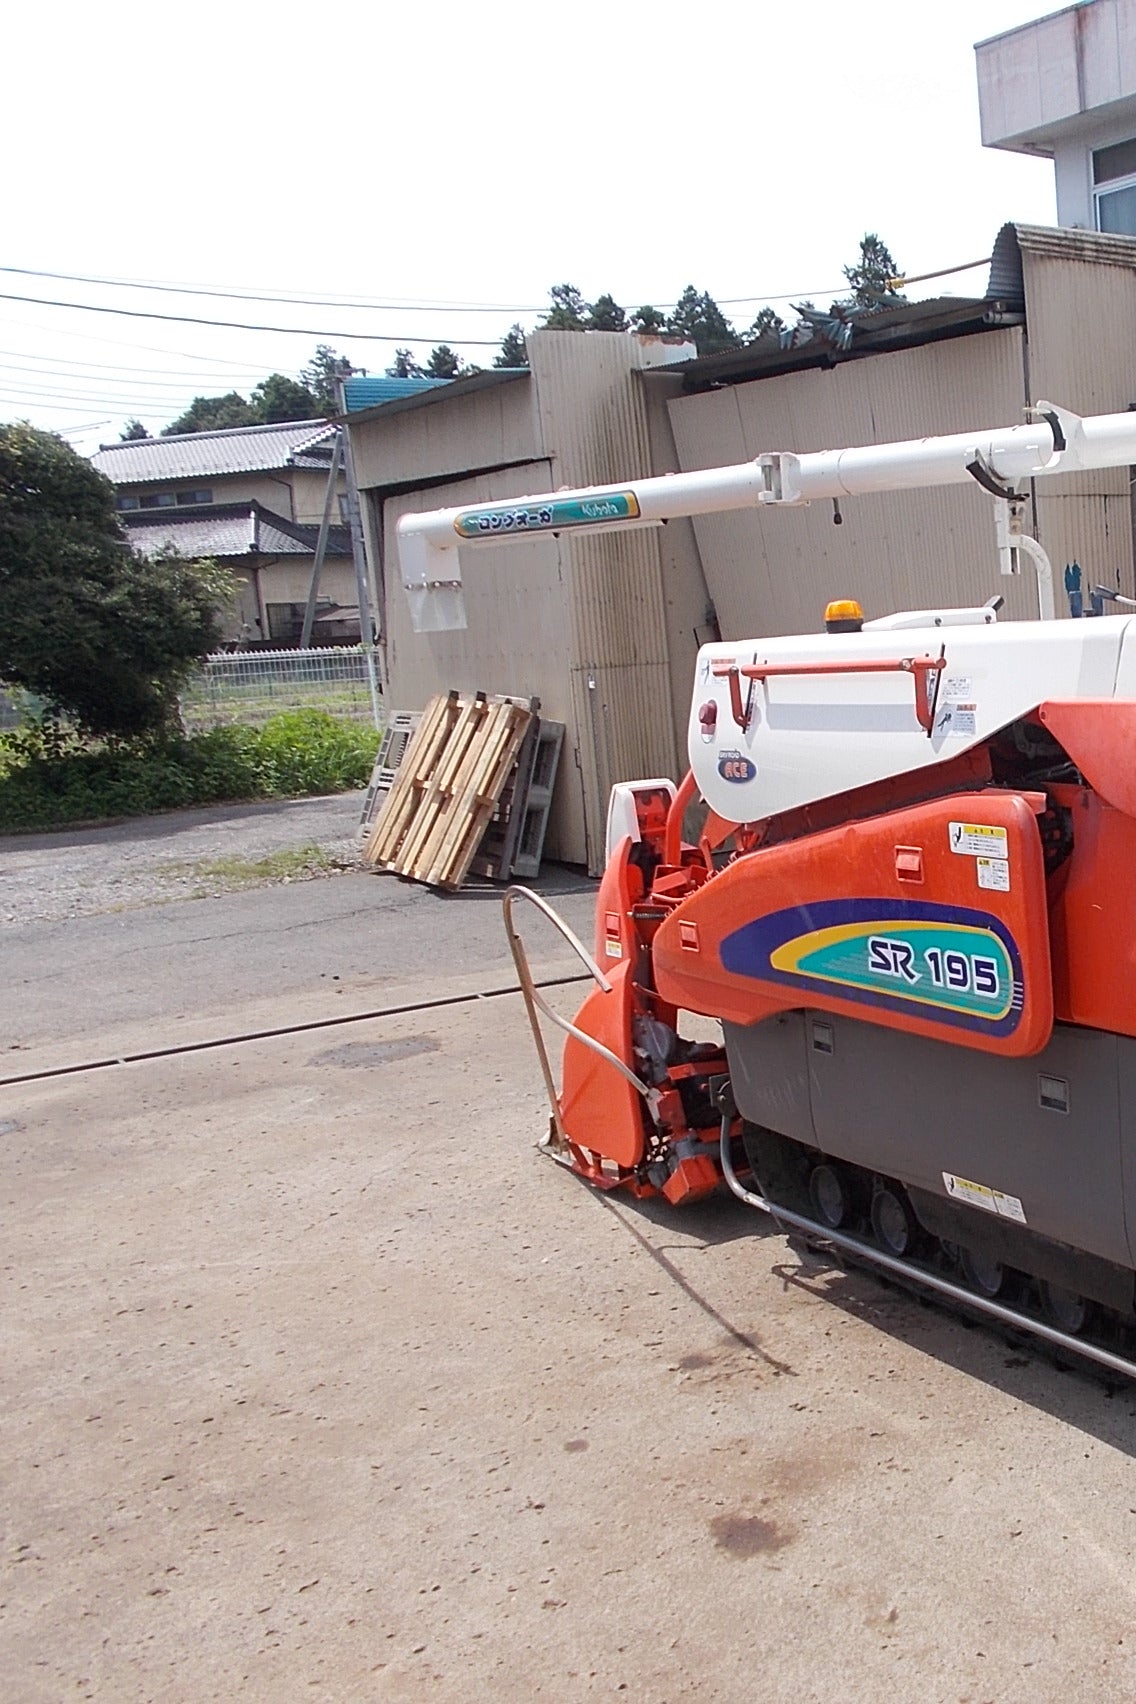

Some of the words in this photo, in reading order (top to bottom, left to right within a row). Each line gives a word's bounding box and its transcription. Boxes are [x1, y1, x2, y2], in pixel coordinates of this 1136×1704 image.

[478, 505, 554, 530] ロングオーガ
[581, 501, 619, 516] Kubota
[724, 761, 748, 779] ACE
[869, 938, 919, 983] SR
[926, 949, 998, 996] 195
